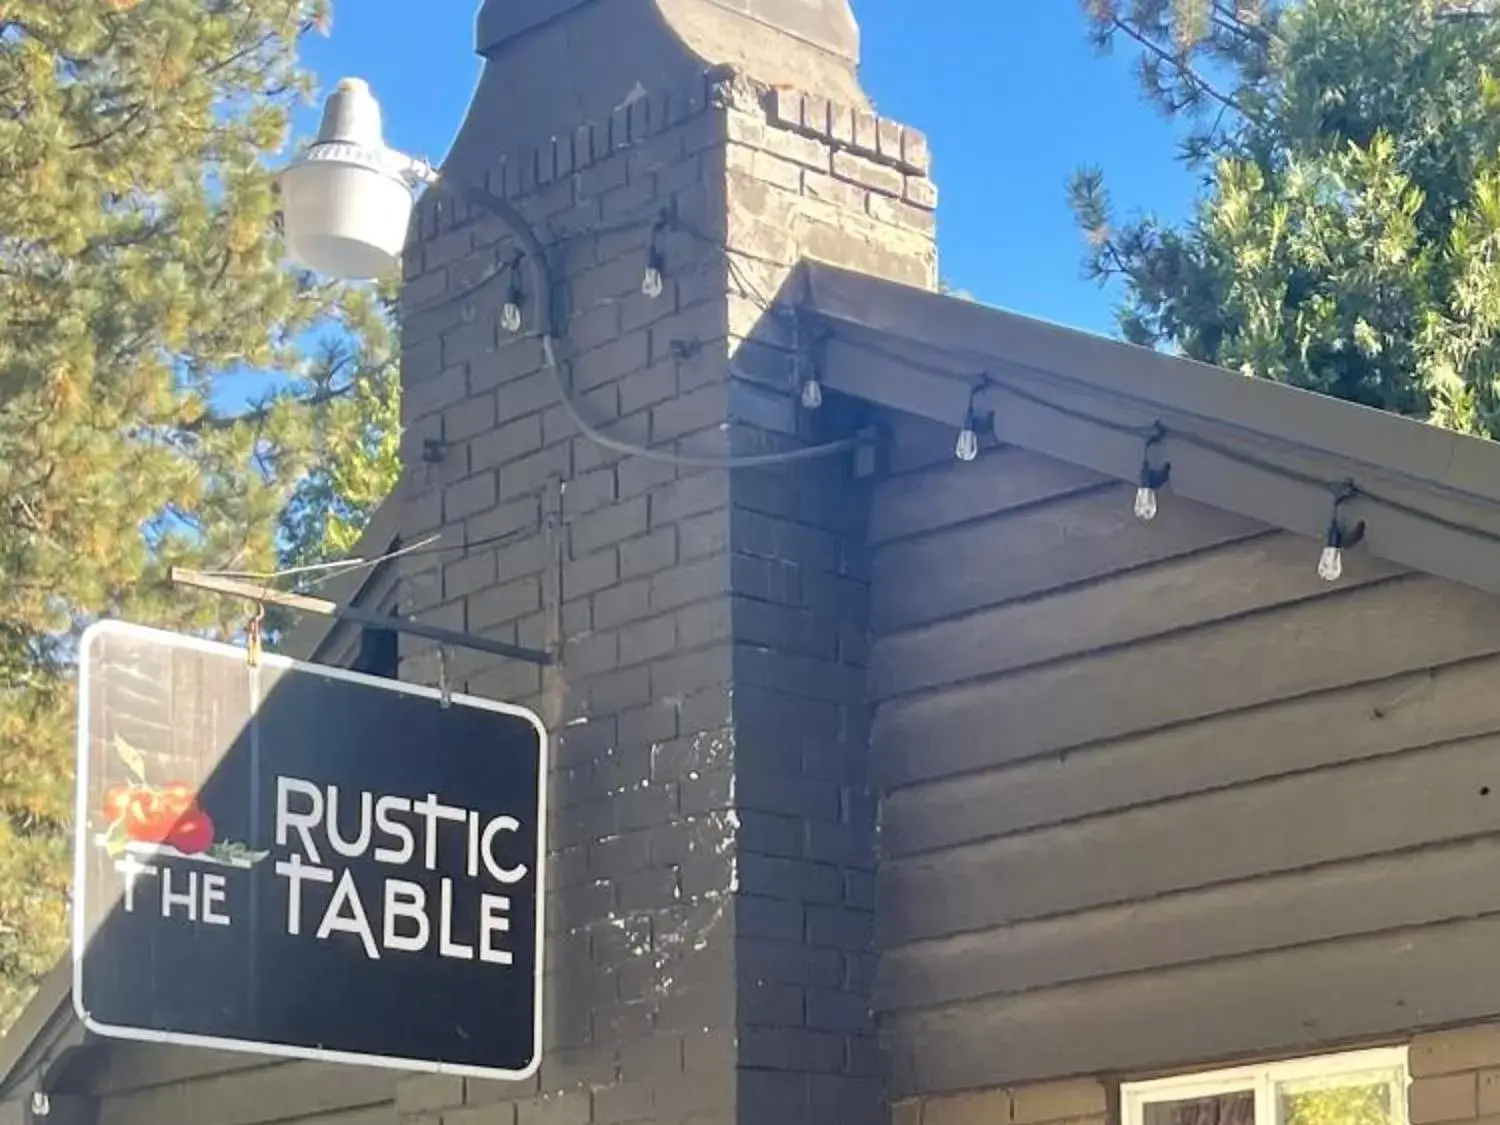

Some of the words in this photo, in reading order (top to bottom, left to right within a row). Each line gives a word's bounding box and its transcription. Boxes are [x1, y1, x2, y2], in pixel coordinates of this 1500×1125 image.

[275, 775, 528, 884] RUSTIC
[113, 854, 231, 926] THE
[275, 854, 514, 965] TABLE
